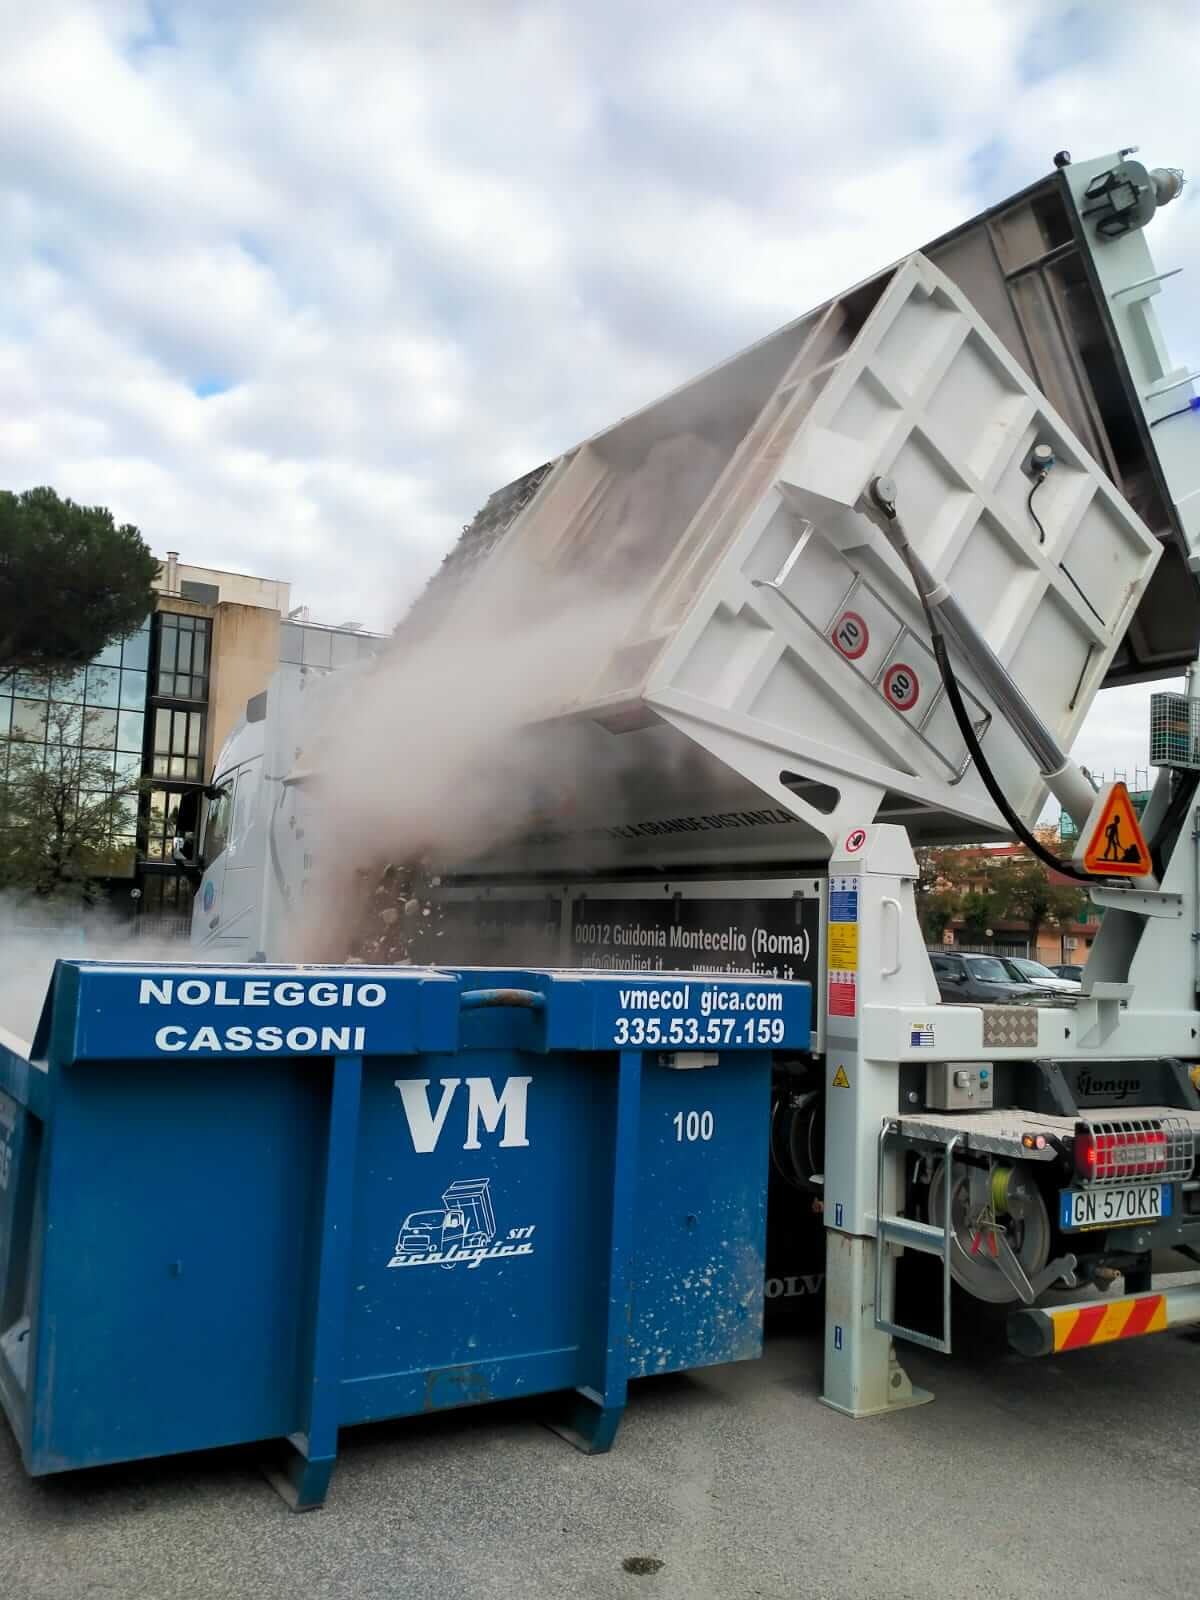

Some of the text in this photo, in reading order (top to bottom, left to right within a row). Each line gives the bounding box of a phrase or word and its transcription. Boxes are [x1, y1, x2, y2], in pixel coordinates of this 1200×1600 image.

[839, 622, 859, 647] 70
[891, 674, 910, 699] 80
[638, 816, 710, 835] GRANDE
[701, 808, 800, 831] DISTANZA
[575, 924, 611, 945] 00012
[613, 924, 667, 948] Guidonia
[669, 926, 747, 951] Montecelio
[751, 927, 810, 962] (Roma)
[138, 978, 387, 1008] NOLEGGIO
[154, 1025, 366, 1051] CASSONI
[613, 1017, 785, 1045] 335.53.57.159
[393, 1076, 534, 1154] VM
[673, 1110, 714, 1142] 100
[1074, 1187, 1160, 1223] GN 570KR
[505, 1225, 536, 1241] srl
